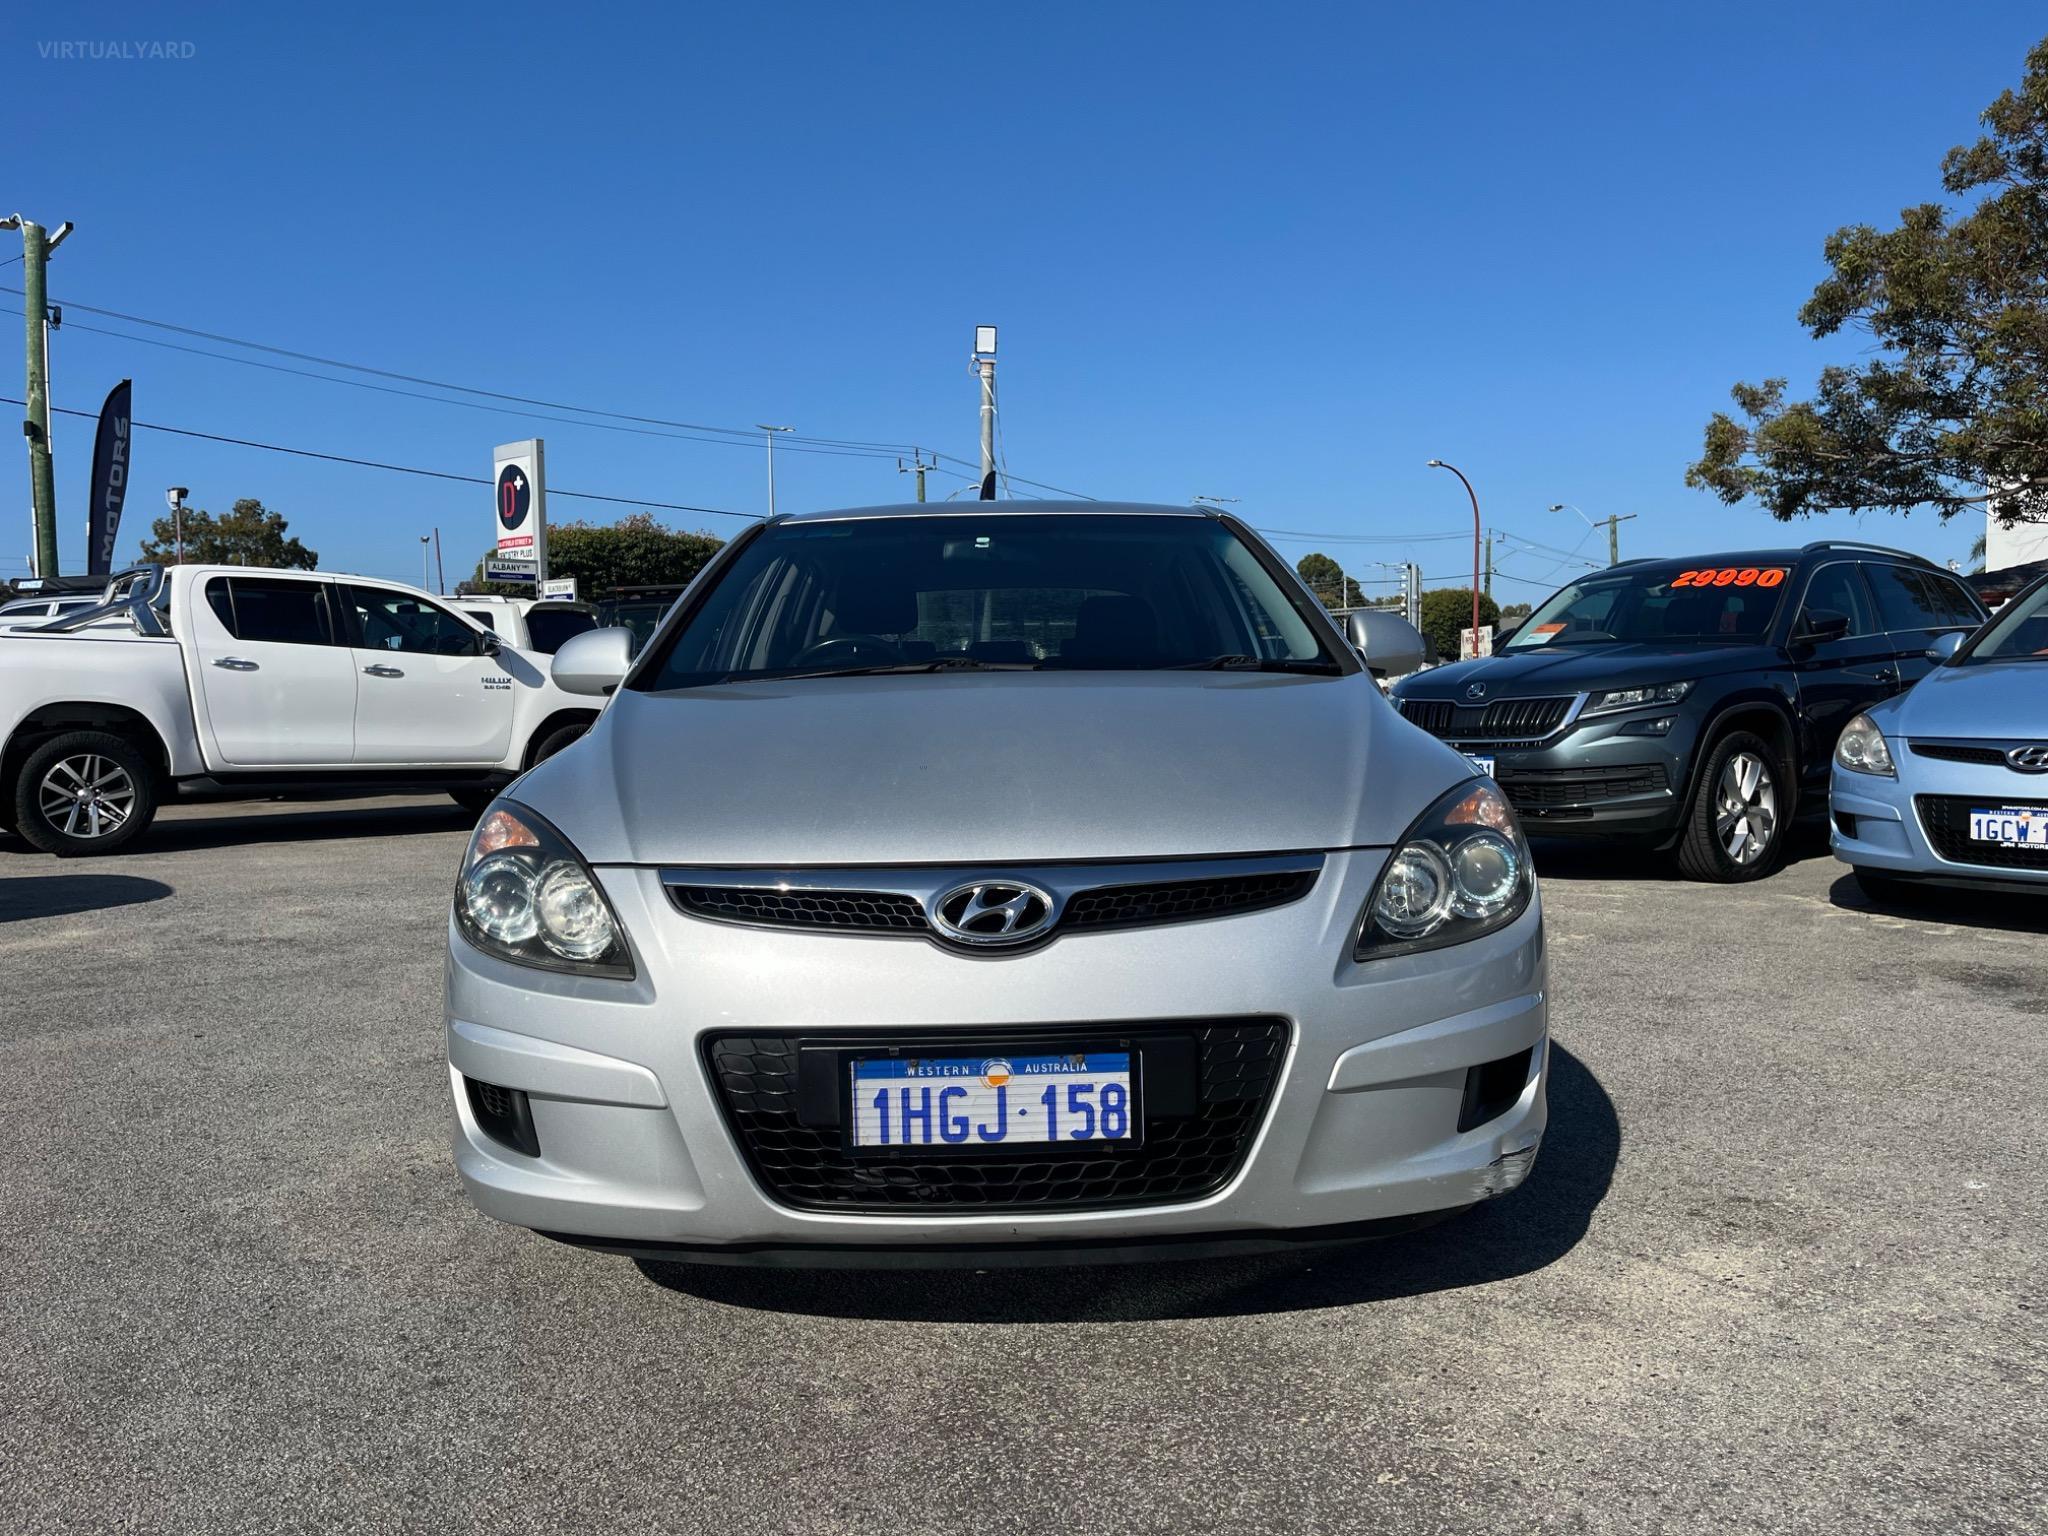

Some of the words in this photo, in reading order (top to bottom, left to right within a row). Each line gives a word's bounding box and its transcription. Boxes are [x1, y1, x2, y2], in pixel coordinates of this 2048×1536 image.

[102, 416, 128, 561] MOTORS
[520, 549, 533, 558] PLUS
[492, 562, 521, 572] ALBANY
[1671, 568, 1784, 587] 29990
[906, 1065, 969, 1077] WESTERN
[1025, 1062, 1088, 1074] AUSTRALIA
